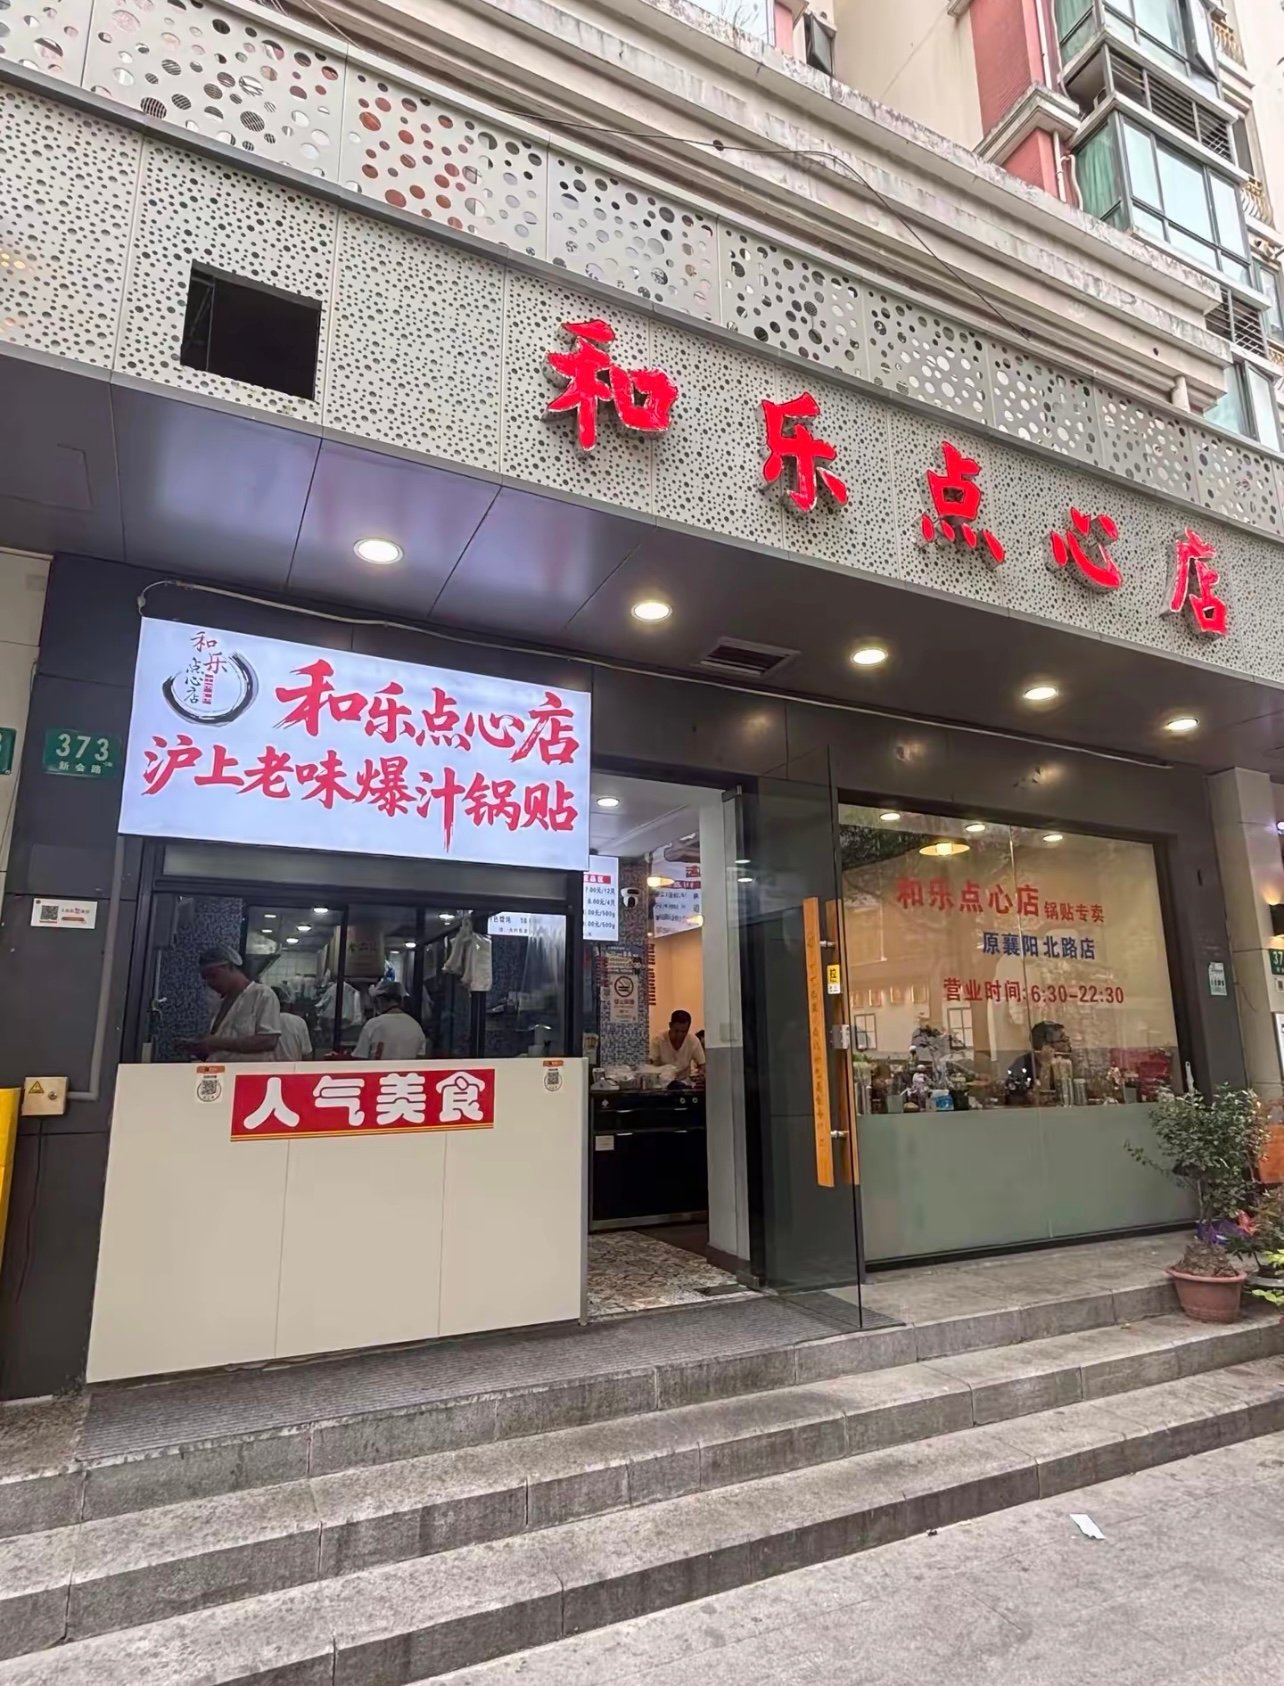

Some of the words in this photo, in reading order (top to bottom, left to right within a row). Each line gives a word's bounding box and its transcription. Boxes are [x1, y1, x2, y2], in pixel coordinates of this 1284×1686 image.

[547, 318, 1229, 637] 和乐点心店
[190, 631, 228, 674] 和乐
[183, 657, 205, 704] 点心店
[273, 659, 580, 766] 和乐点心店
[56, 733, 109, 761] 373
[141, 733, 579, 853] 沪上老味爆汁锅贴
[896, 877, 1040, 917] 和乐点心店
[1043, 901, 1105, 923] 锅贴专卖
[982, 931, 1096, 960] 原襄阳北路店
[243, 1071, 486, 1130] 人气美食
